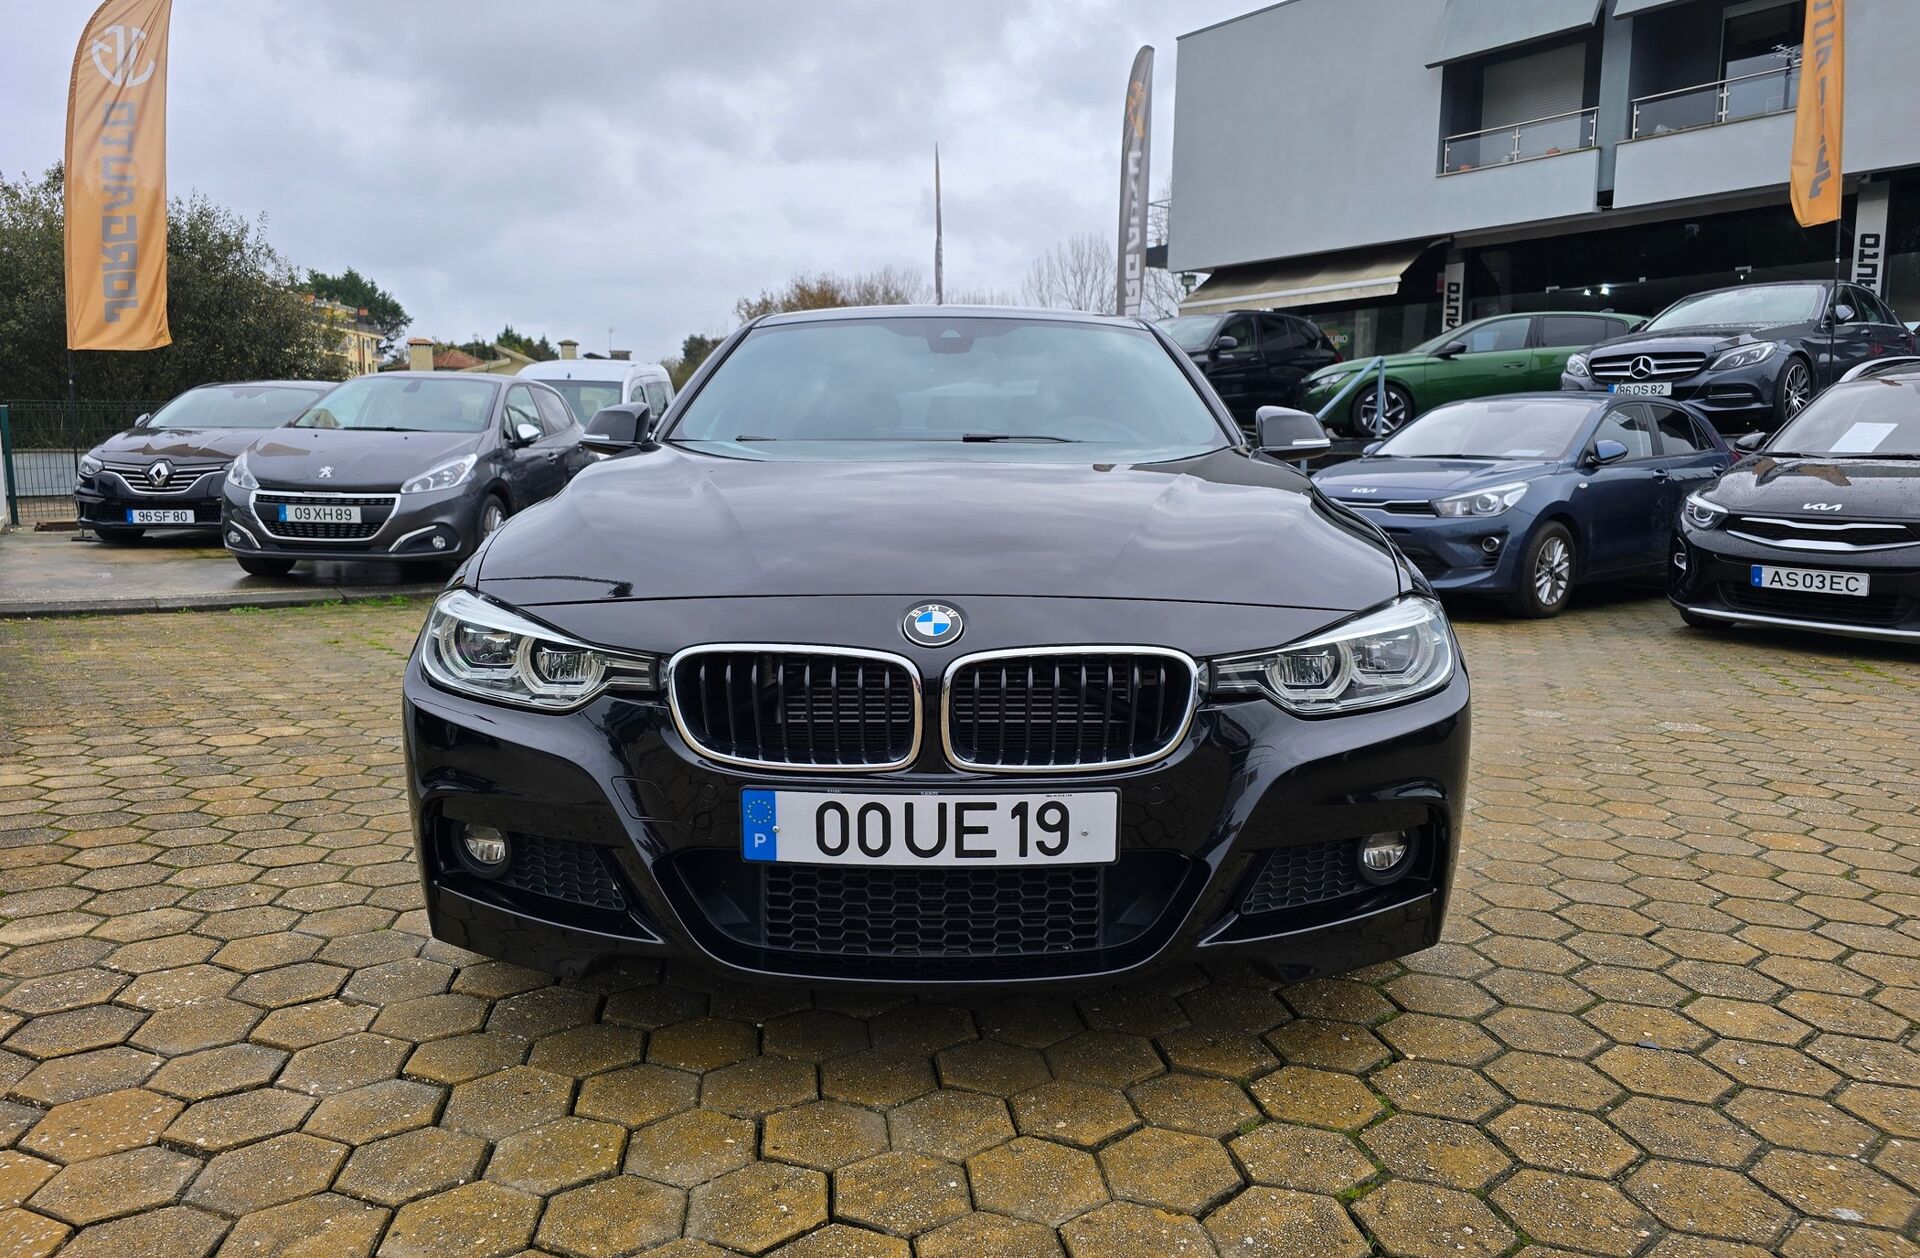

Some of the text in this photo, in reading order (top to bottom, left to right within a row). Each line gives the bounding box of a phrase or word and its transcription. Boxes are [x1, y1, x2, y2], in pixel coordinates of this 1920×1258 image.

[1855, 233, 1880, 294] AUTO
[1446, 282, 1460, 330] AUTO
[911, 604, 957, 618] BMW
[753, 833, 767, 848] P
